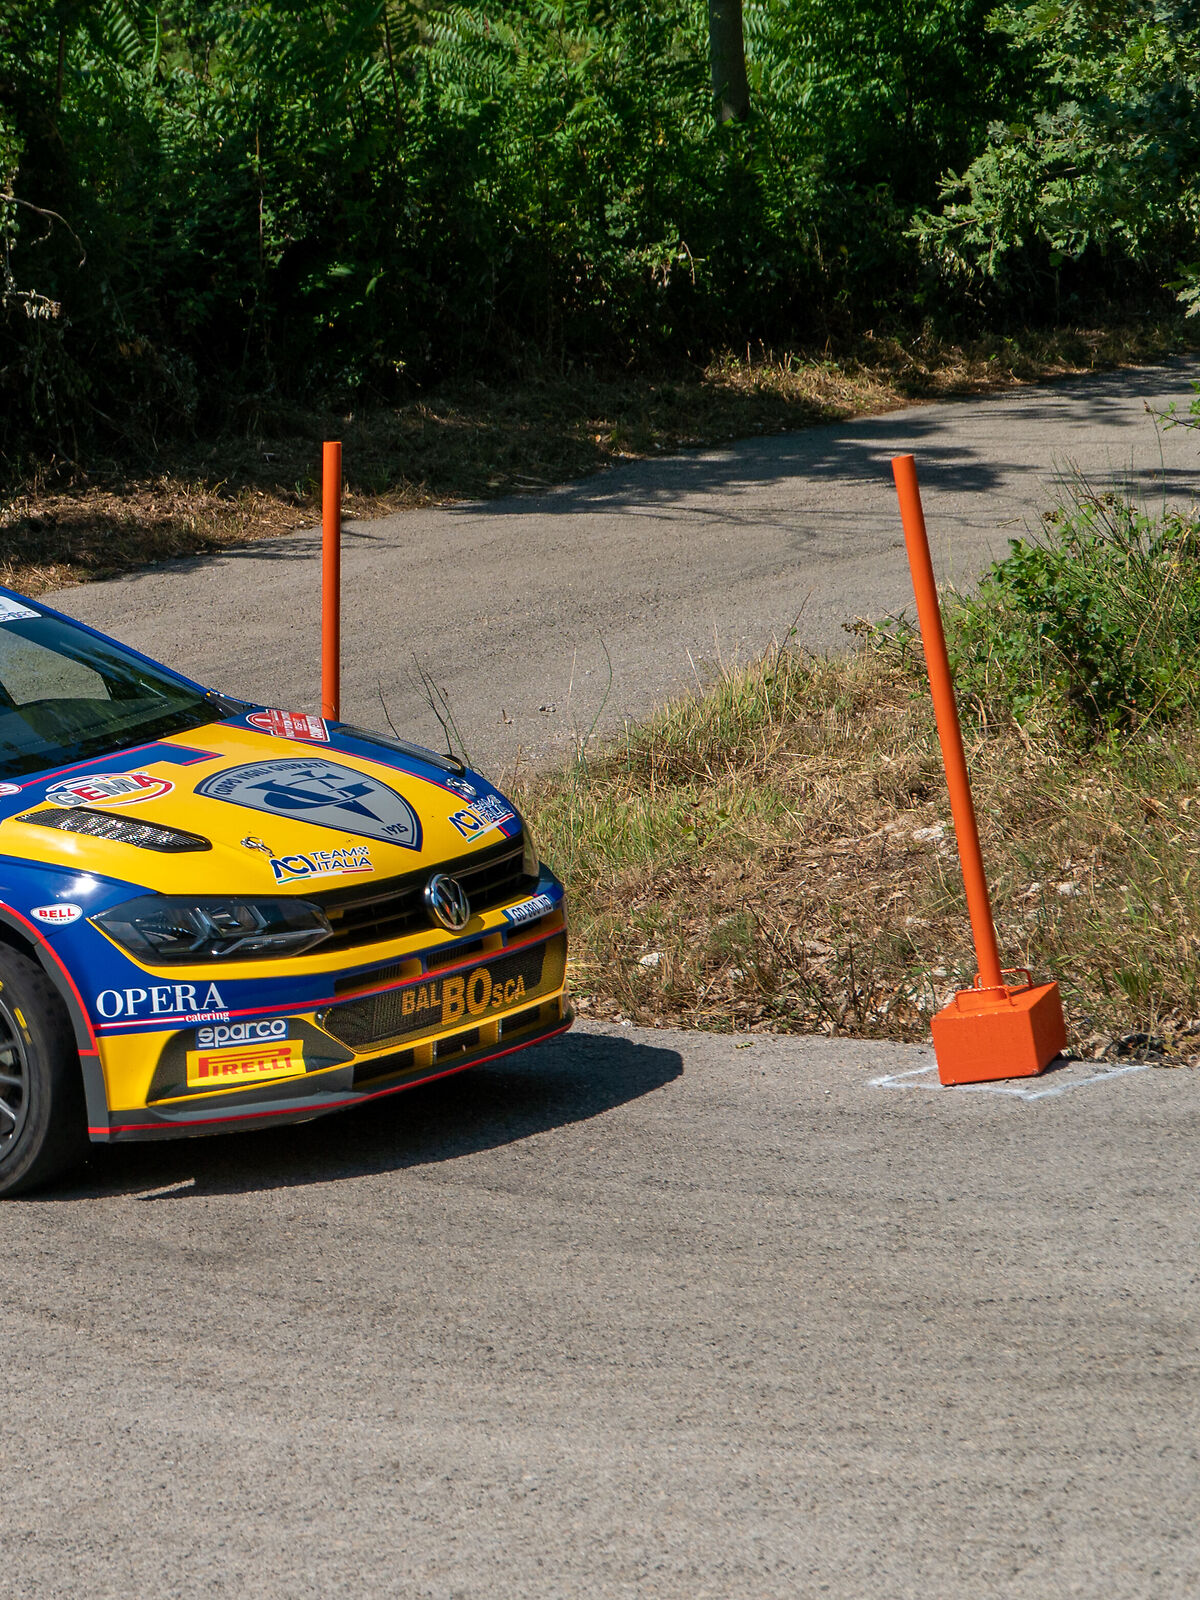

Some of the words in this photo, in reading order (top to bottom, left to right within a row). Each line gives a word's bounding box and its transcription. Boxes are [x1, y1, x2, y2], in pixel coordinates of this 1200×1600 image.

[47, 775, 166, 806] GEMA
[380, 823, 409, 836] 1925
[310, 847, 357, 861] TEAM
[317, 858, 373, 871] ITALIA
[39, 908, 75, 918] BELL
[96, 982, 229, 1018] OPERA
[185, 1010, 230, 1023] catering
[198, 1019, 286, 1047] sparco
[198, 1047, 292, 1078] PIRELLI
